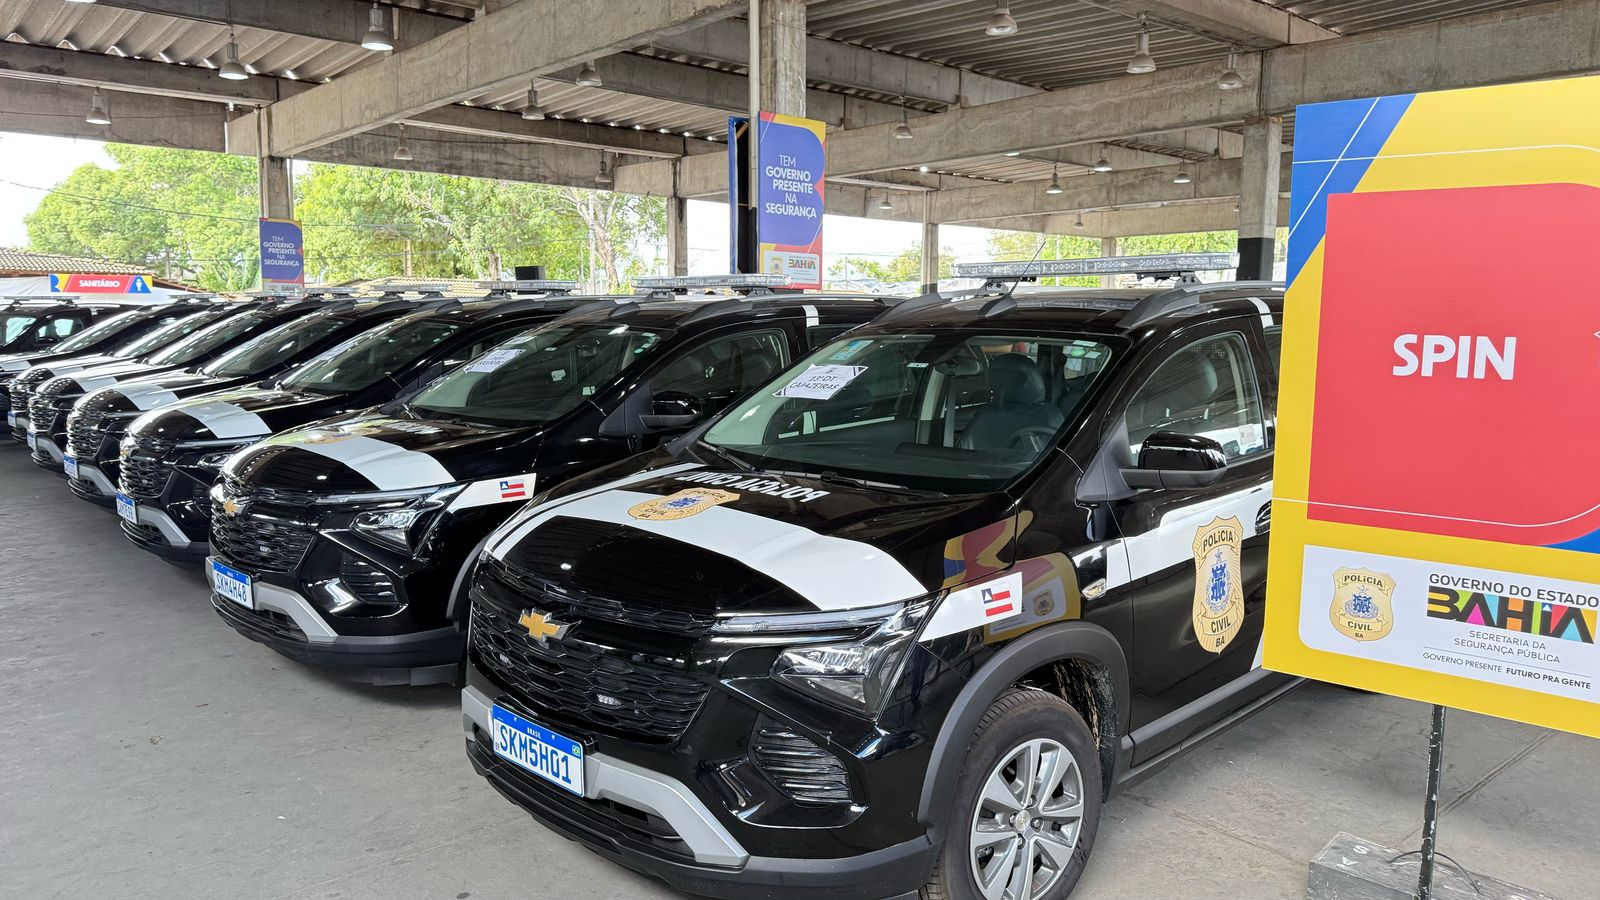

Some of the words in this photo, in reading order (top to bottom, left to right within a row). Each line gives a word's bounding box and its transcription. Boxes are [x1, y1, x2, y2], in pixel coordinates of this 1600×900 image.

[779, 154, 796, 167] TEM
[765, 166, 811, 182] GOVERNO
[773, 179, 813, 194] PRESENTE
[785, 192, 798, 204] NA
[765, 202, 817, 220] SEGURANÇA
[263, 241, 294, 249] GOVERNO
[272, 235, 284, 243] TEM
[268, 247, 297, 255] PRESENTE
[264, 258, 300, 268] SEGURANÇA
[79, 279, 120, 288] SANITÁRIO
[1392, 333, 1517, 381] SPIN
[1429, 572, 1504, 594] GOVERNO
[1509, 584, 1532, 598] DO
[1536, 588, 1600, 608] ESTADO
[1427, 585, 1596, 645] BAHIA
[1210, 618, 1232, 634] CIVIL
[1347, 620, 1373, 631] CIVIL
[1215, 636, 1226, 648] BA
[1469, 630, 1530, 648] SECRETARIA
[1532, 640, 1546, 650] DA
[1454, 637, 1514, 655] SEGURANÇA
[1517, 648, 1561, 664] PÚBLICA
[1422, 652, 1464, 666] GOVERNO
[1465, 659, 1503, 673] PRESENTE
[1506, 667, 1541, 680] FUTURO
[1542, 674, 1560, 684] PRA
[1561, 678, 1592, 690] GENTE
[500, 724, 572, 784] SKM5H01
